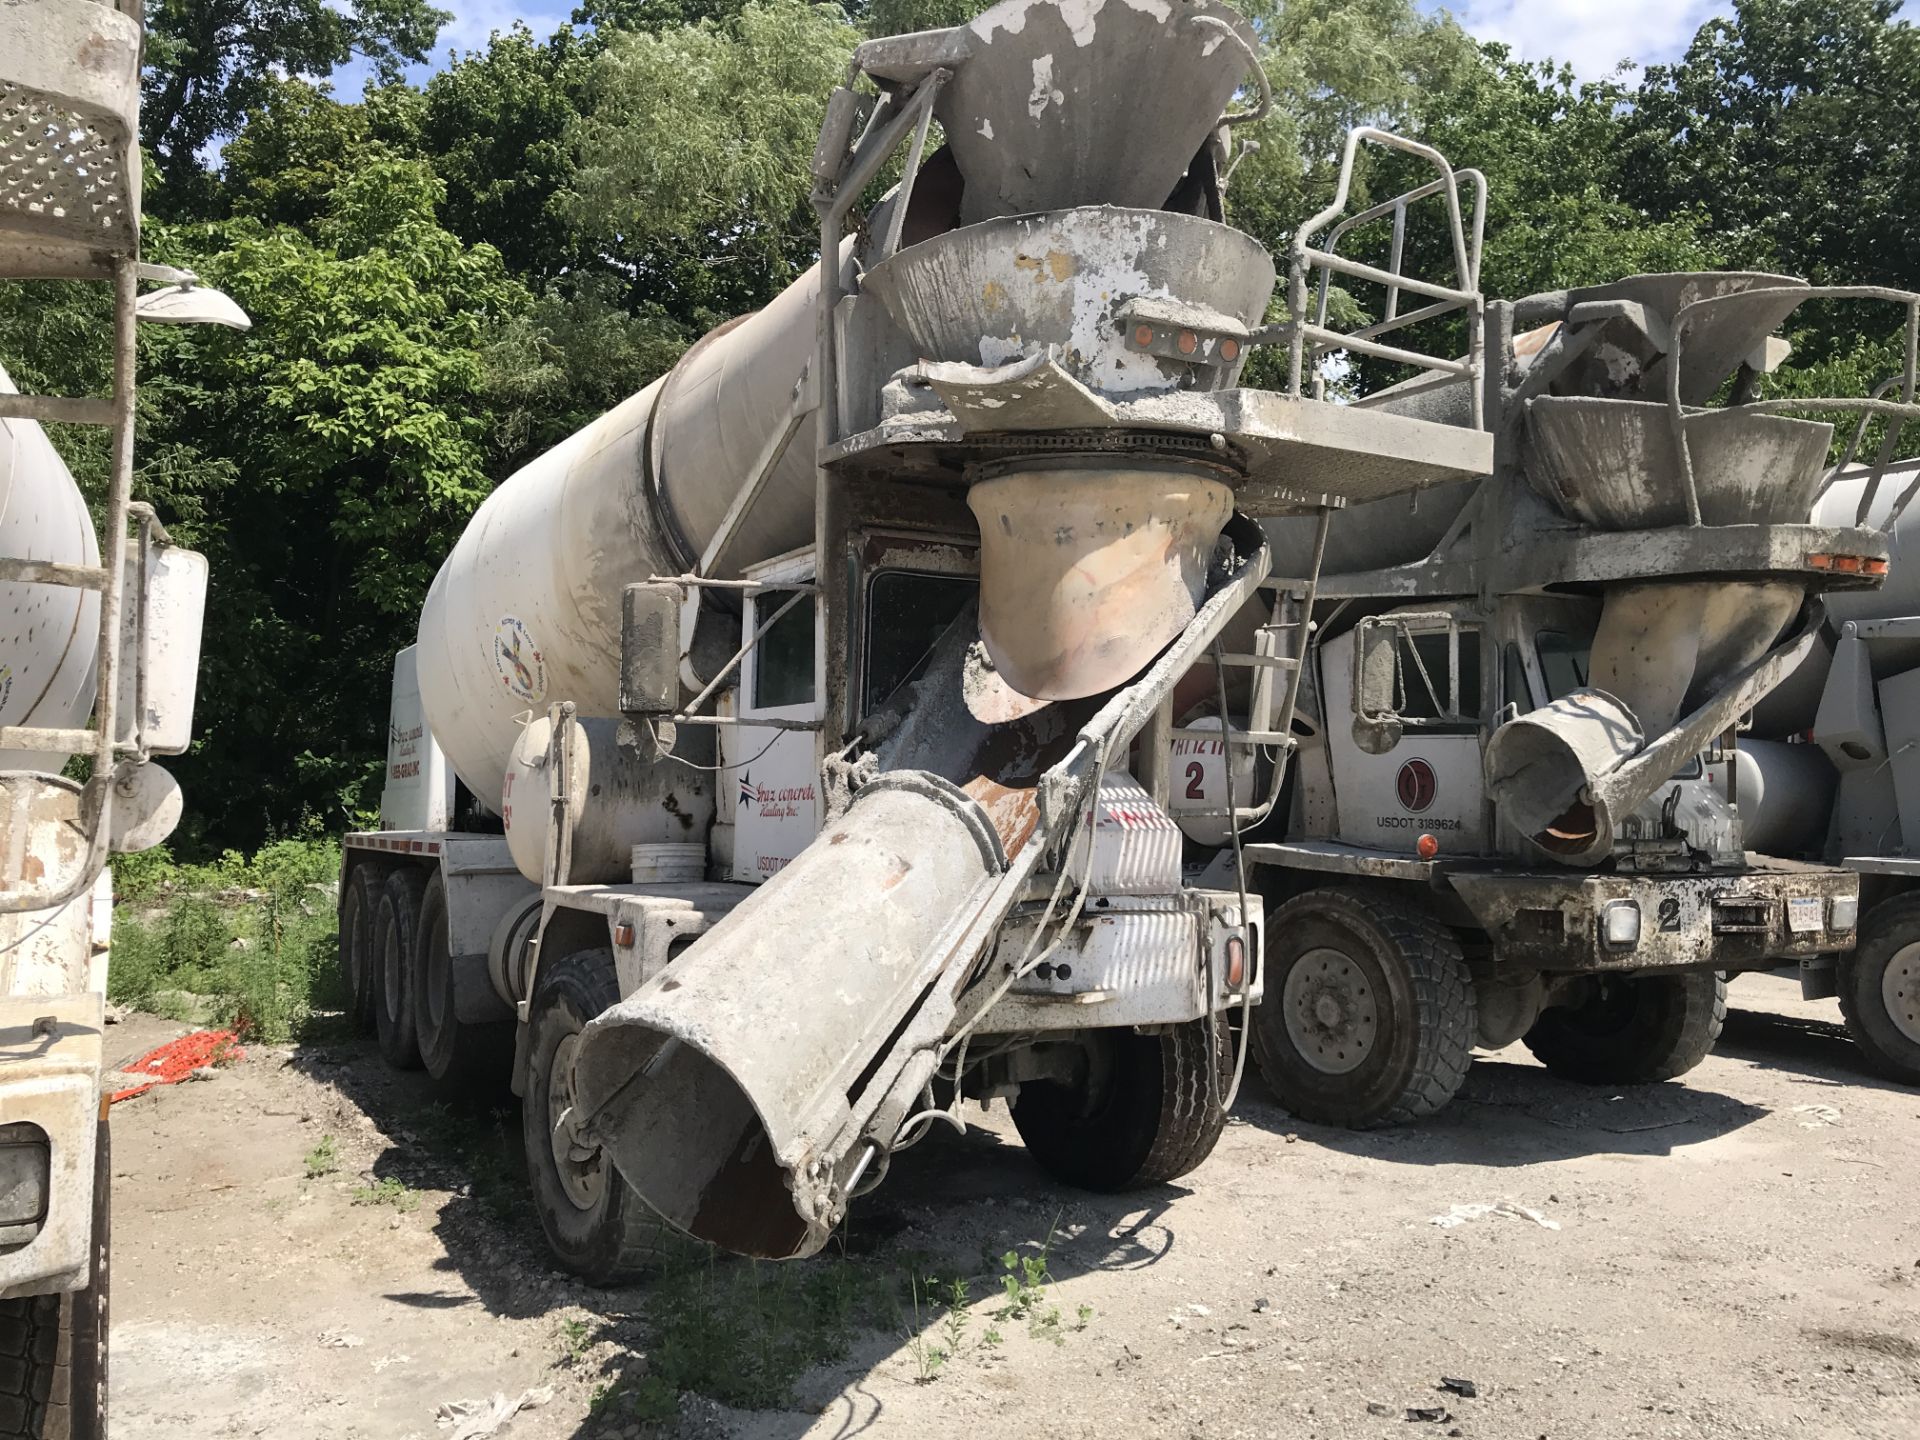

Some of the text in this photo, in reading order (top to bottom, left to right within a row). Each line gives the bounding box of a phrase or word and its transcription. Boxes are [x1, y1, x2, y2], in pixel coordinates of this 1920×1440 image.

[1185, 761, 1205, 800] 2
[778, 783, 816, 802] concrete
[759, 804, 785, 822] Hauling
[1376, 817, 1461, 831] USDOT 3189624
[756, 855, 778, 872] USDOT
[1658, 898, 1681, 933] 2
